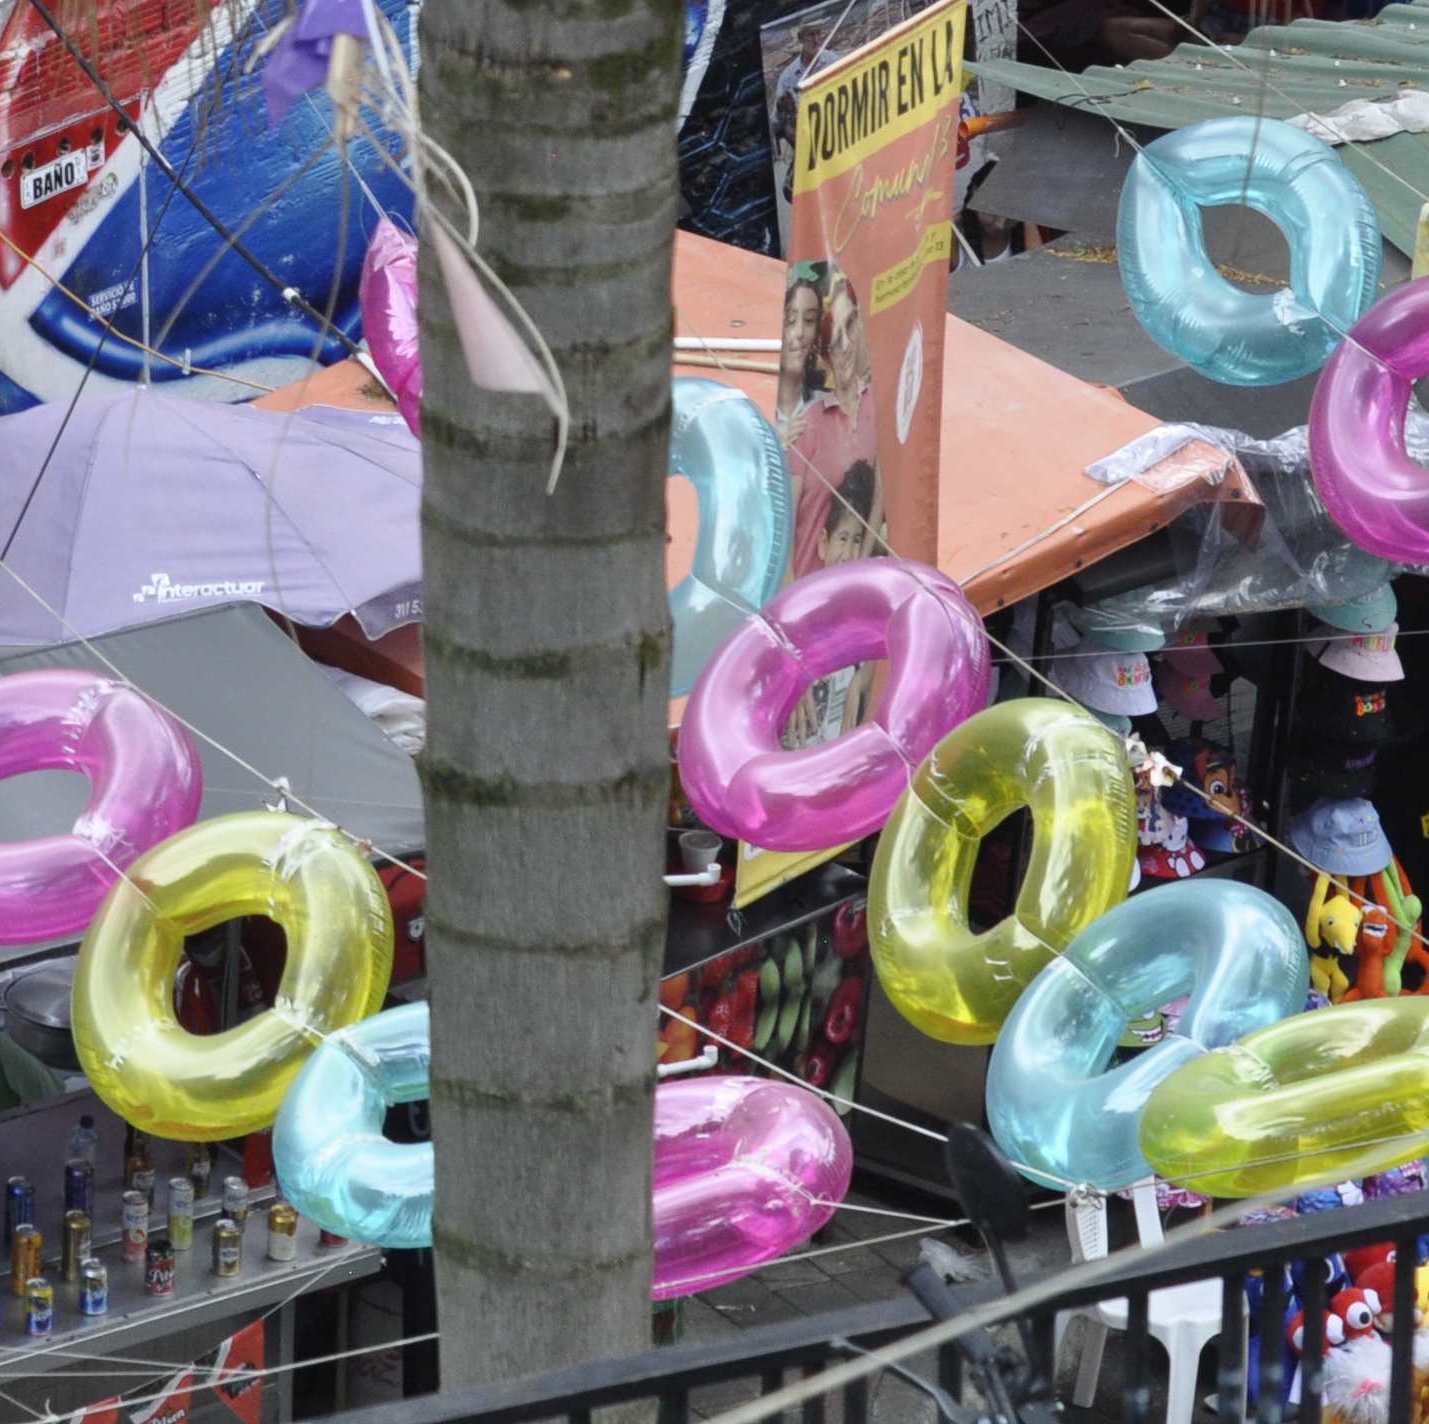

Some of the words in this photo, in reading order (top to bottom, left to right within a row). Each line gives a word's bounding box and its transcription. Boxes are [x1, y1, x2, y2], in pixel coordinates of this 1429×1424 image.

[808, 60, 890, 172] DORMIR
[897, 38, 924, 117] EN
[33, 159, 75, 201] BAÑO
